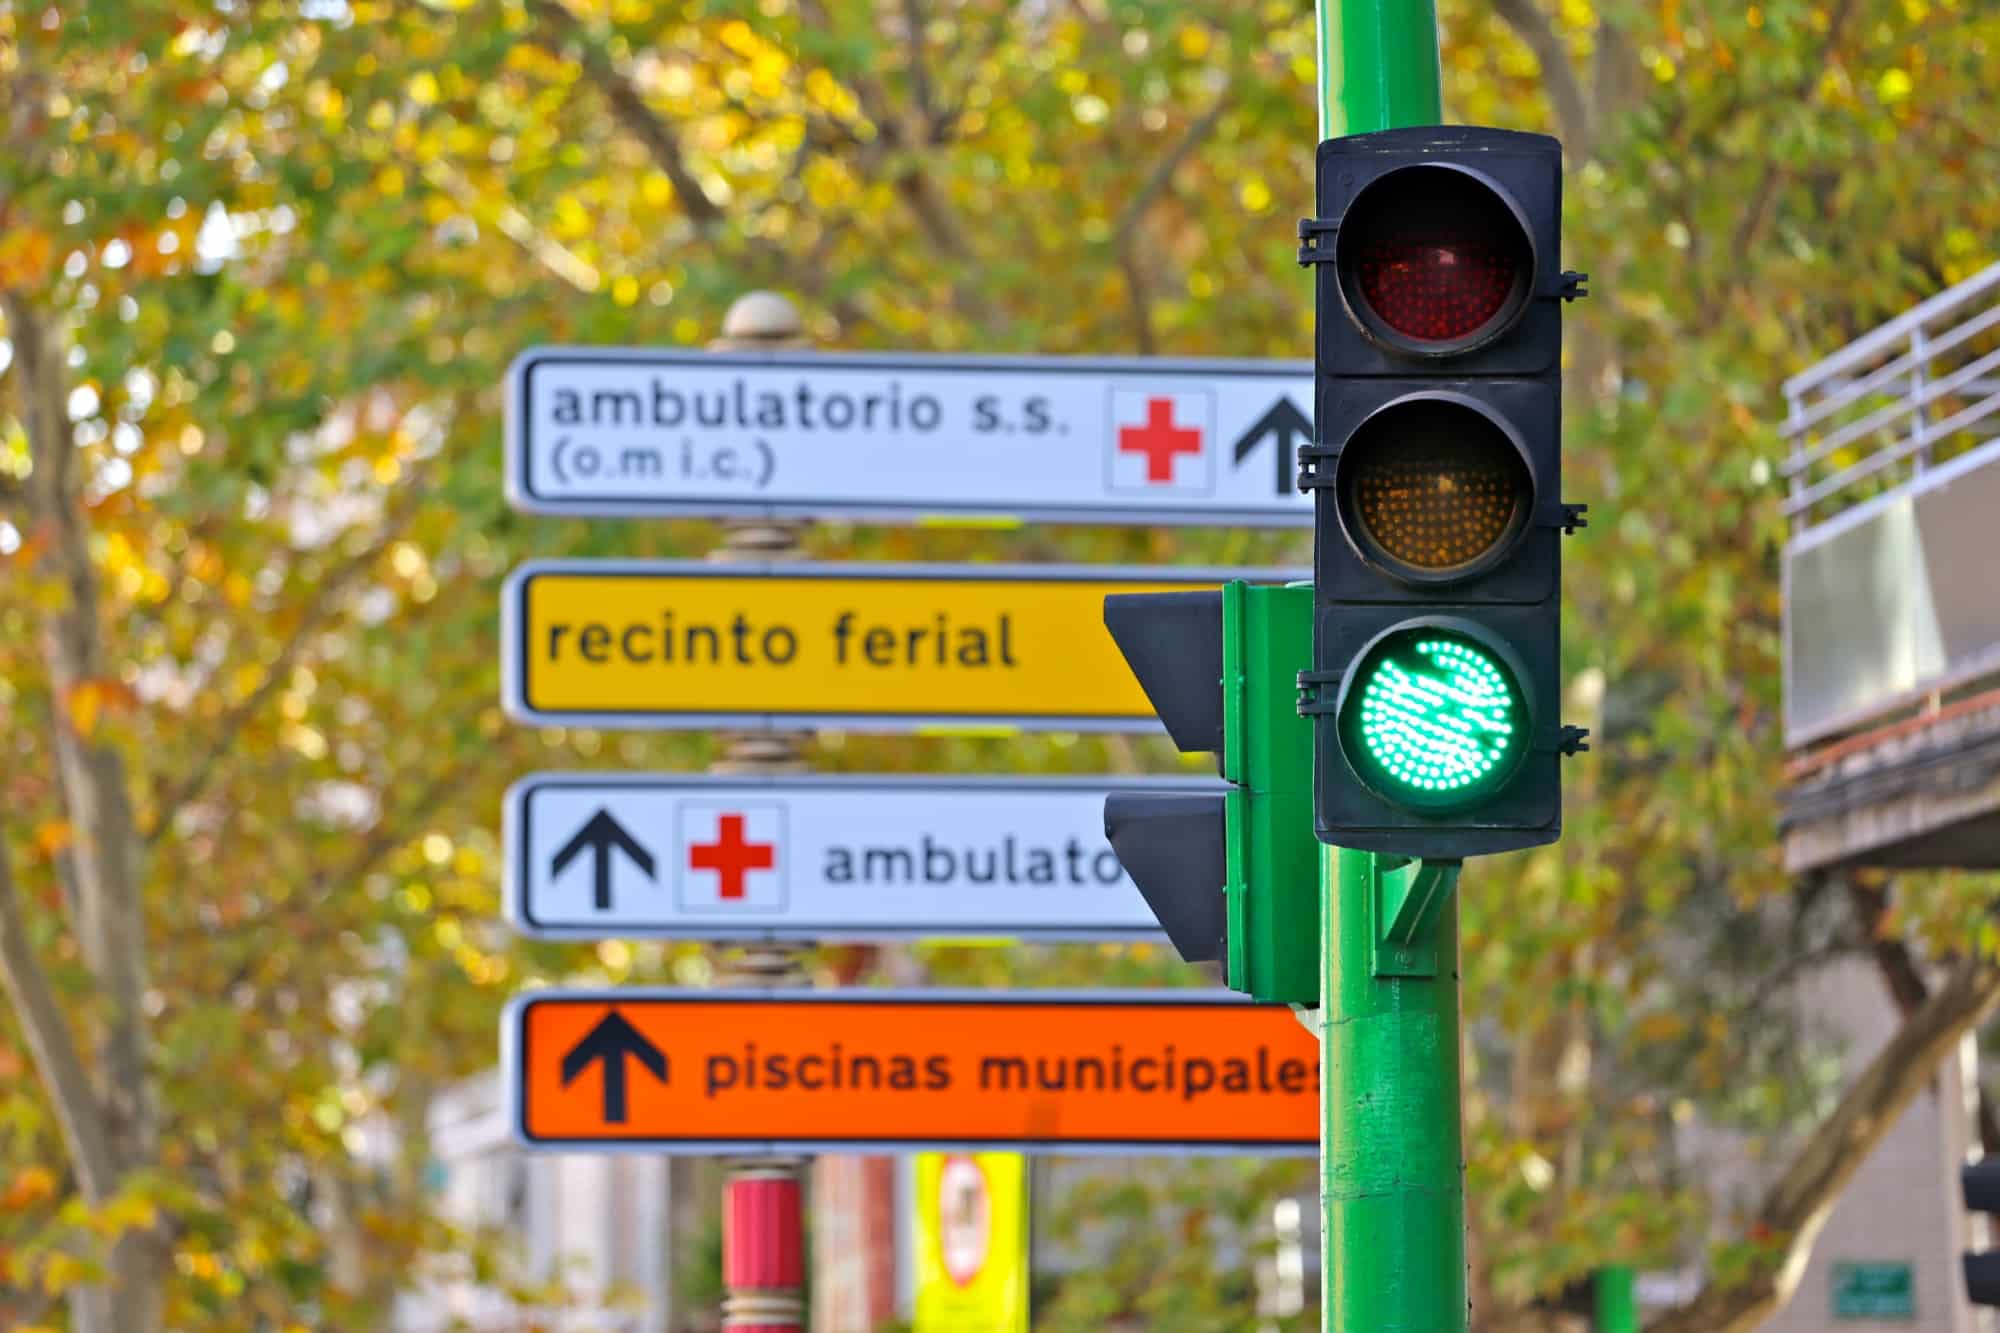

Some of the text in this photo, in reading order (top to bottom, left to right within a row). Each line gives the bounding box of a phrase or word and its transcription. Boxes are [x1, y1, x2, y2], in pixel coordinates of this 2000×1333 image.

[552, 380, 1070, 436] ambulatorio s.s.
[548, 611, 1018, 668] recinto ferial
[705, 1042, 1320, 1101] piscinas municipale
